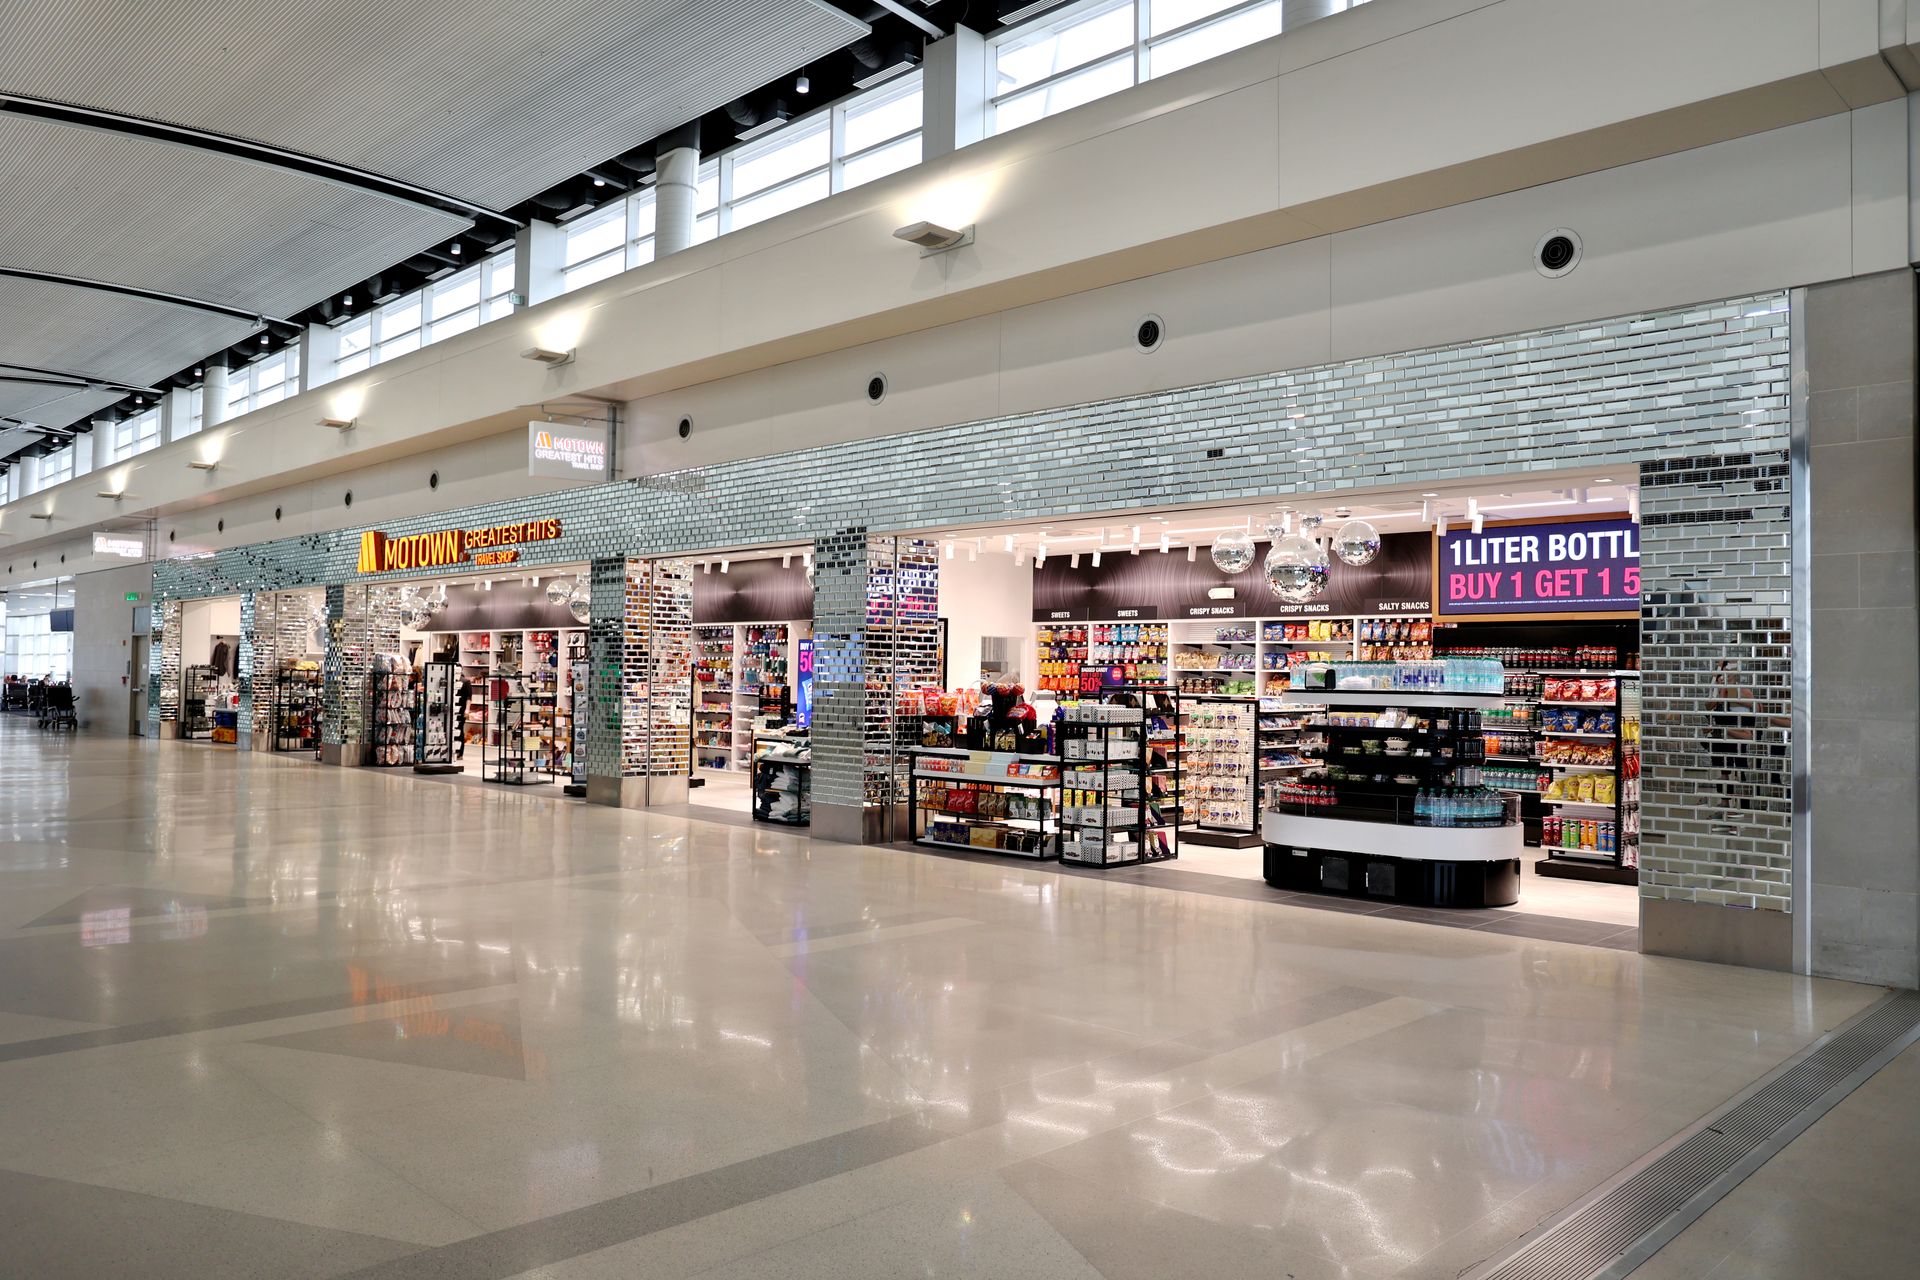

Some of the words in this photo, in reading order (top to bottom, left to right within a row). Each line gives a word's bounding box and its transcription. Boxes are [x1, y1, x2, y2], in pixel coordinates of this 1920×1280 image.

[553, 436, 605, 455] MOTOWN
[535, 449, 582, 463] GREATEST
[584, 454, 604, 465] HITS
[464, 523, 525, 549] GREATEST
[527, 518, 560, 541] HITS
[384, 529, 459, 570] MOTOWN
[475, 552, 496, 566] TRAVEL
[496, 550, 515, 563] SHOP
[1450, 535, 1539, 566] 1LITER
[1450, 572, 1502, 600] BUY
[1510, 571, 1522, 598] 1
[1535, 568, 1588, 597] GET
[1597, 568, 1610, 595] 1
[1280, 605, 1303, 613] CRISPY
[1303, 604, 1329, 612] SNACKS
[1378, 602, 1399, 610] SALTY
[1401, 601, 1430, 610] SNACKS
